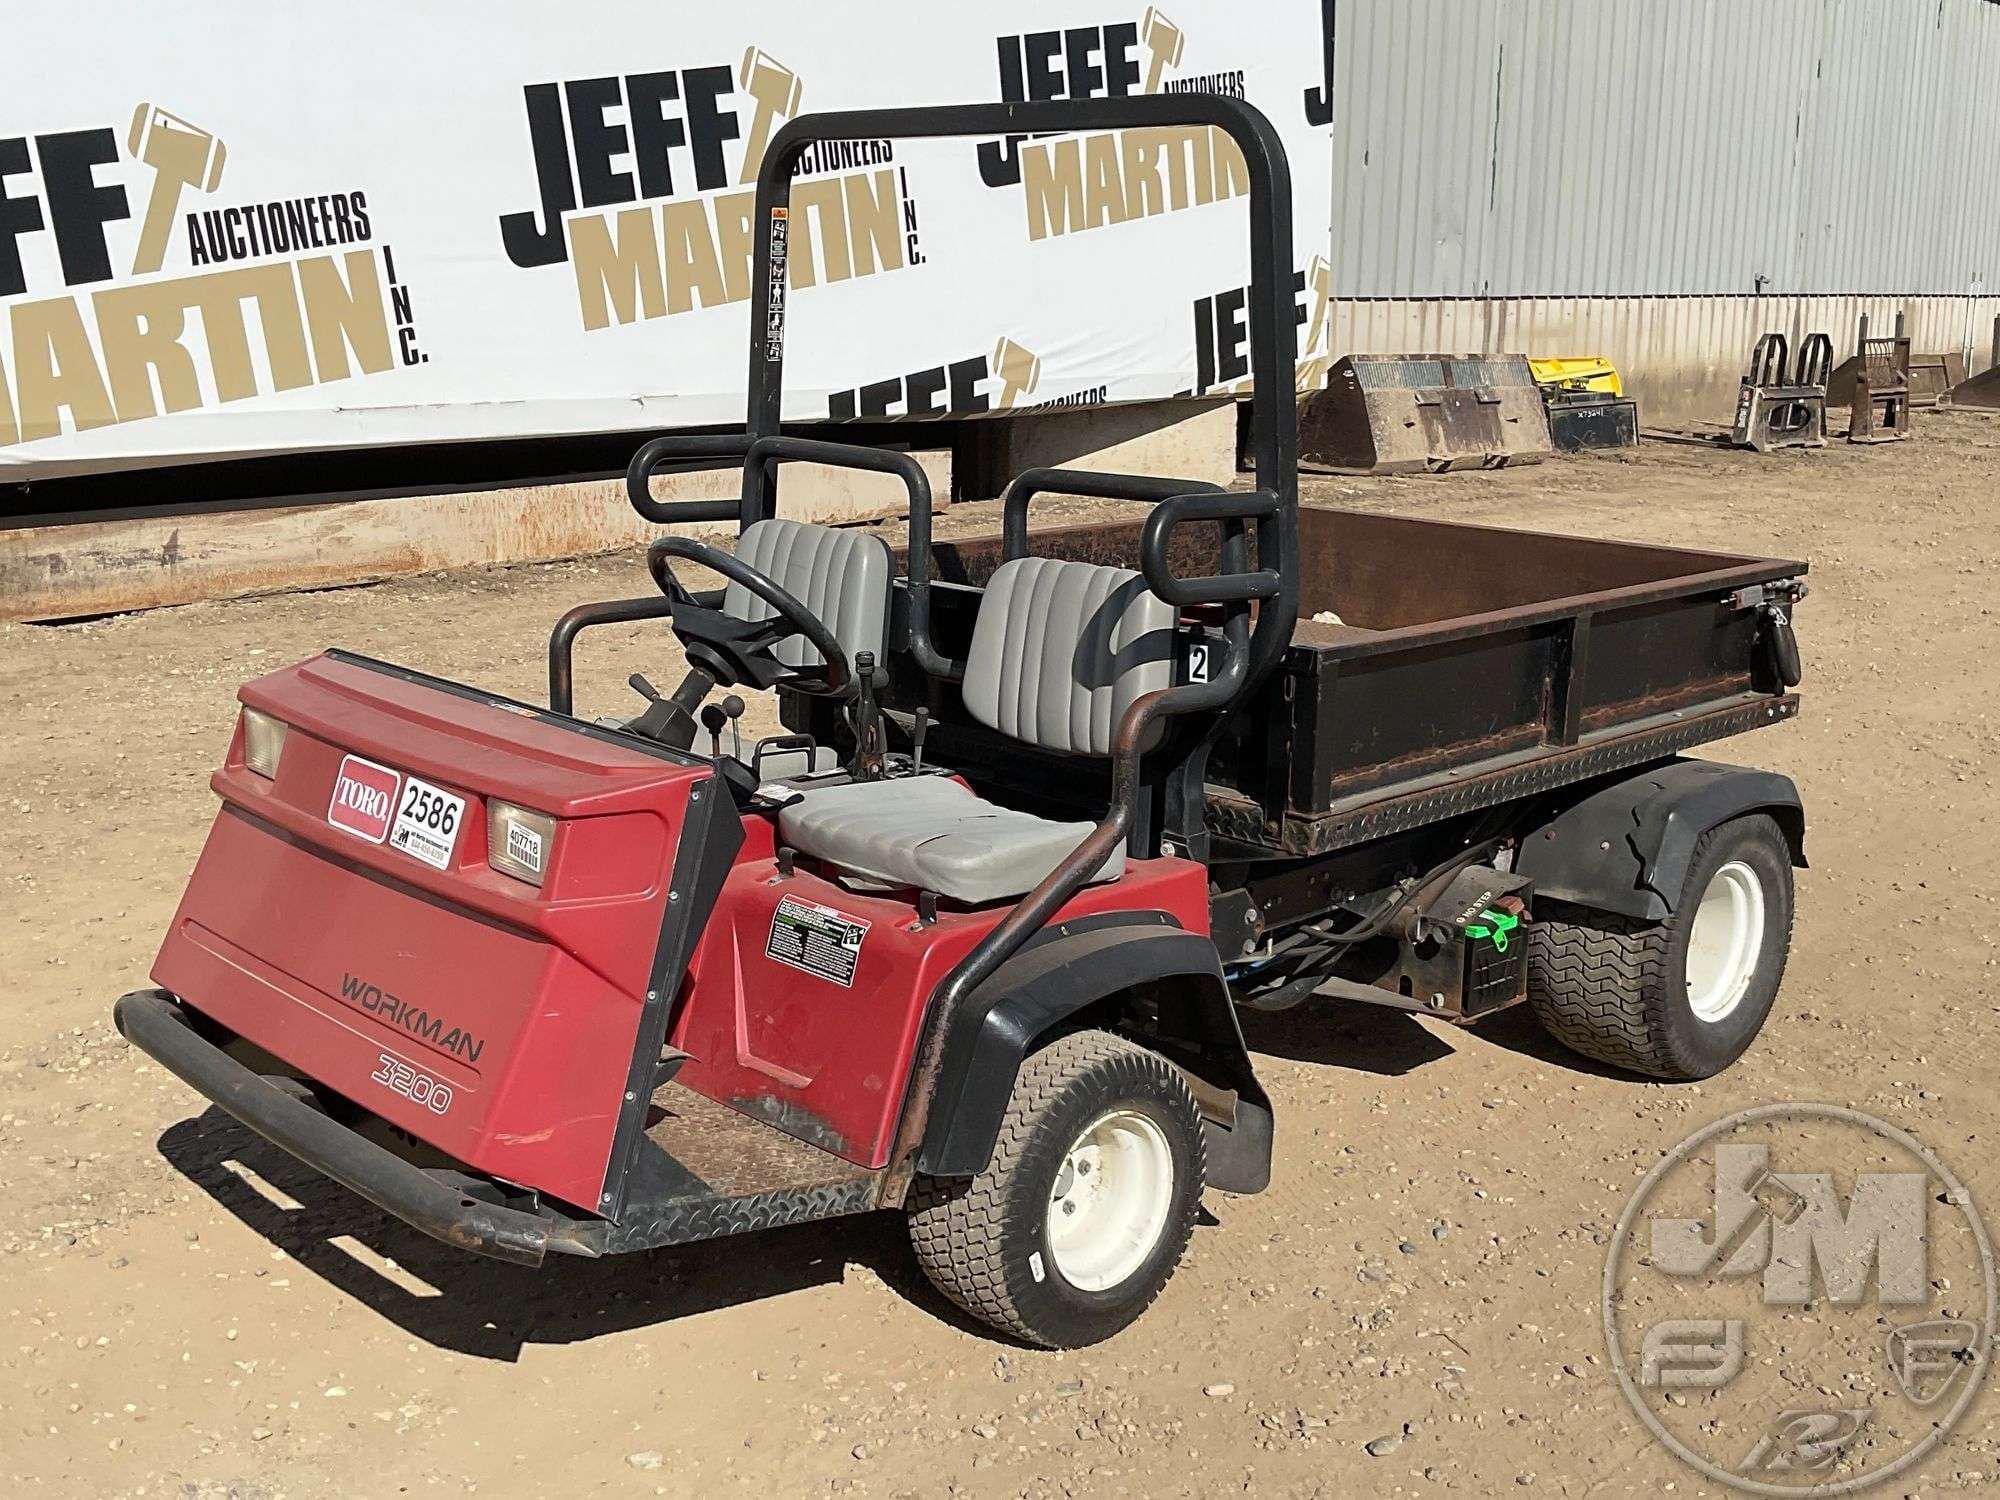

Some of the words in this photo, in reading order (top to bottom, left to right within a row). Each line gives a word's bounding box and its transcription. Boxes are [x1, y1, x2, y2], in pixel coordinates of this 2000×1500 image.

[499, 64, 740, 268] JEFF
[186, 190, 372, 267] AUCTIONEERS
[383, 245, 429, 367] INC.
[0, 249, 394, 448] ARTIN
[1192, 646, 1206, 679] 2
[402, 785, 458, 836] 2586
[510, 828, 538, 855] 407718
[341, 972, 485, 1063] WORKMAN
[371, 1053, 453, 1115] 3200
